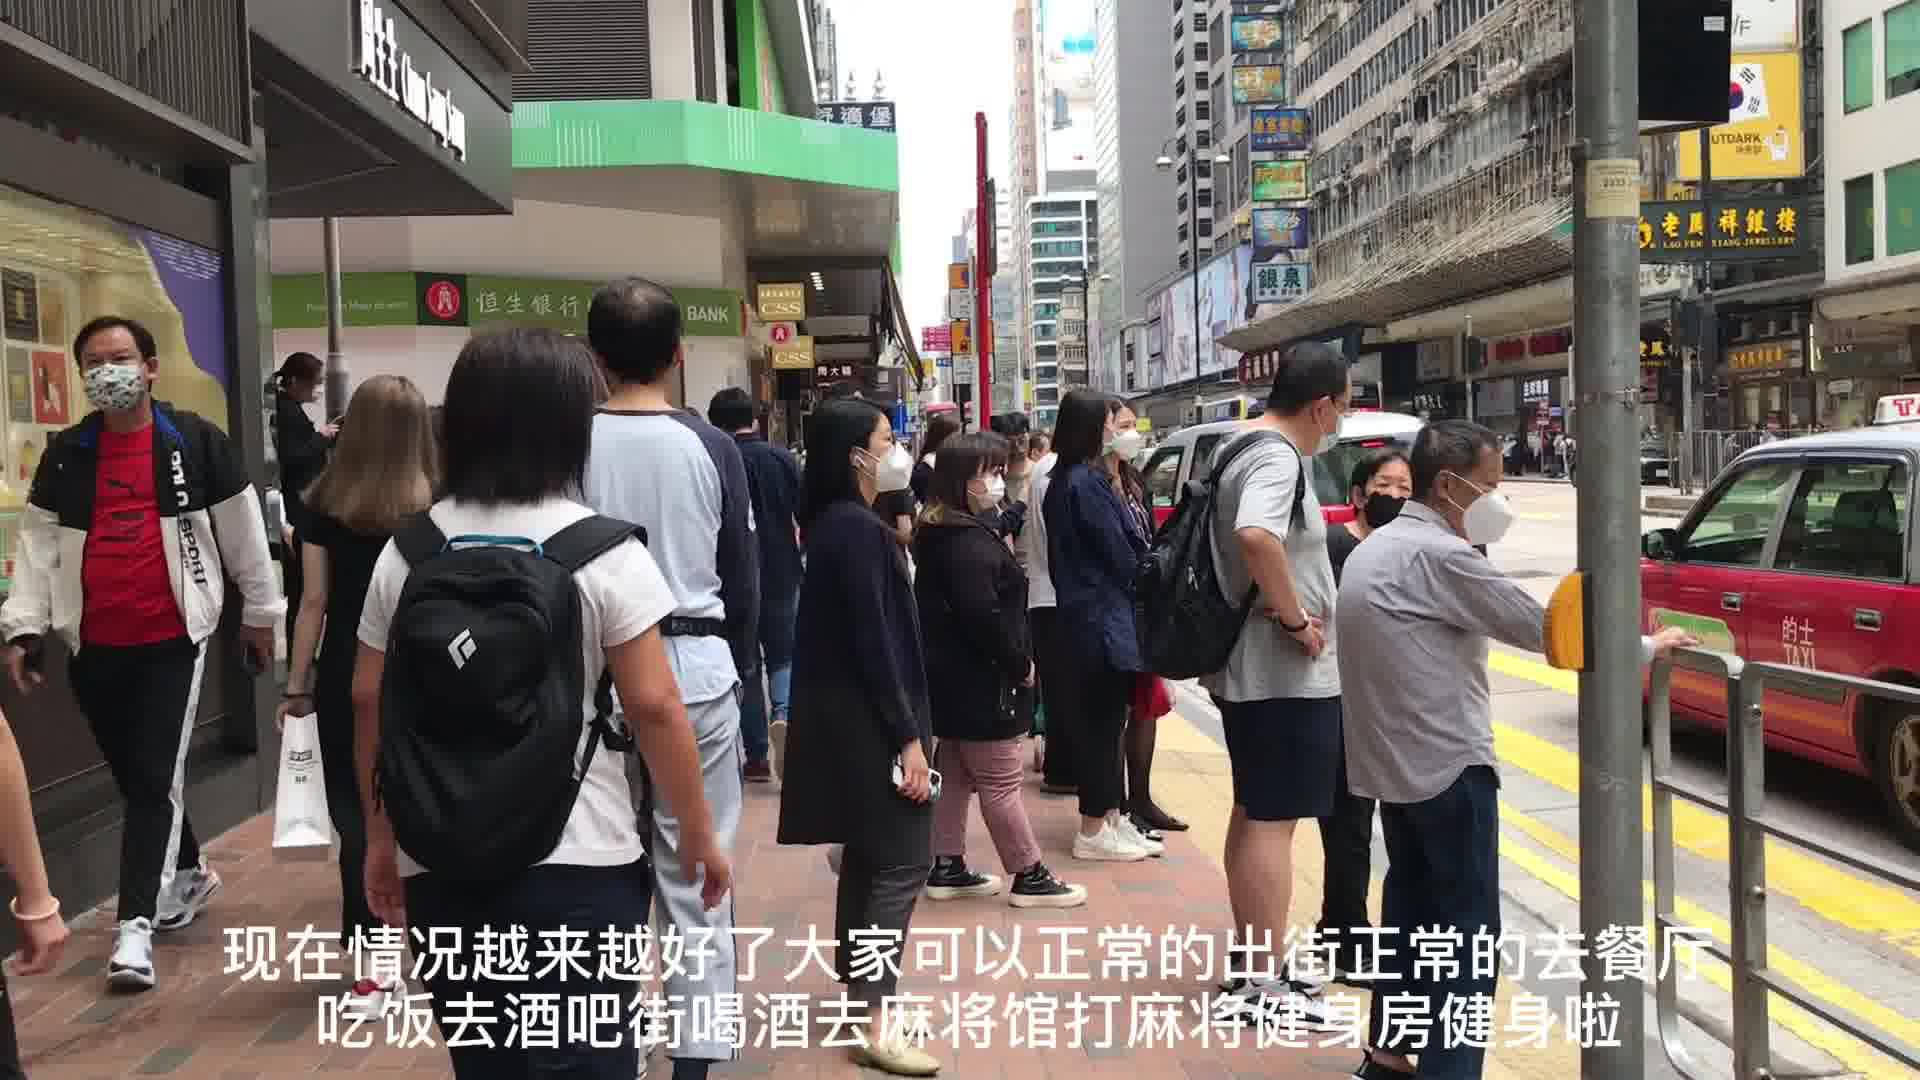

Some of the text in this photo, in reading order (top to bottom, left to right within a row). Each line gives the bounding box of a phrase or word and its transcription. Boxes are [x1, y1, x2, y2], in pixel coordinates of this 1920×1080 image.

[1734, 16, 1751, 36] /F
[1712, 133, 1761, 144] UTDARK
[1257, 267, 1301, 289] 銀泉
[687, 306, 729, 323] BANK
[180, 518, 209, 586] SPORT
[1783, 616, 1815, 648] 的士
[1783, 647, 1816, 672] TAXI
